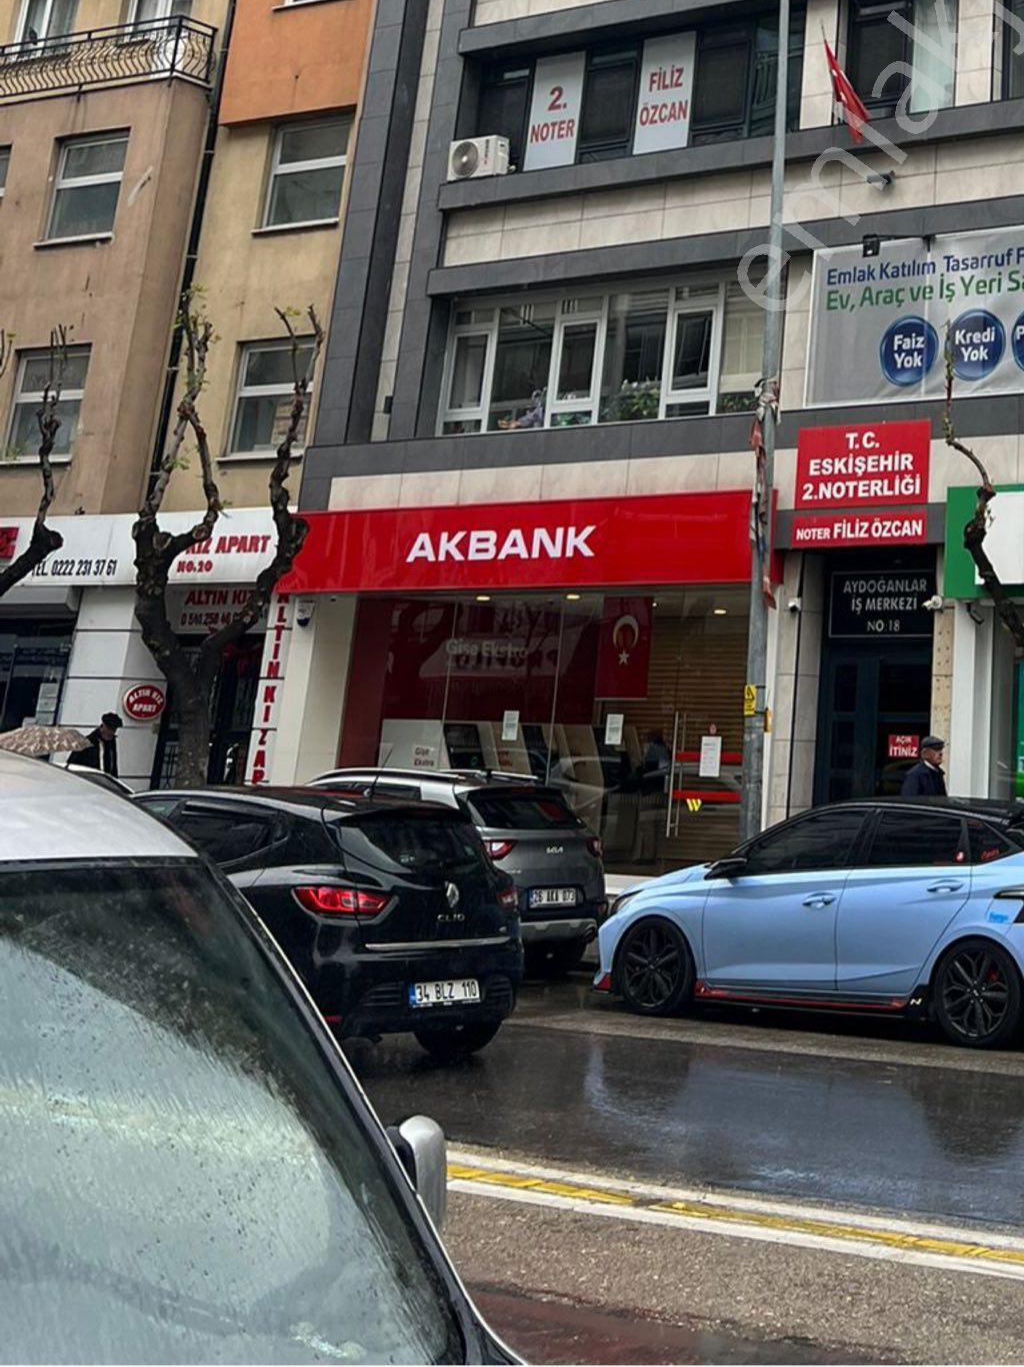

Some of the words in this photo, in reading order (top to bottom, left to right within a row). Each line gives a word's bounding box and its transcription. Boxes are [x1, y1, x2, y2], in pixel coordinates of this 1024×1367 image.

[649, 64, 684, 93] FİLİZ
[548, 86, 567, 111] 2.
[639, 99, 688, 127] ÖZCAN
[530, 119, 575, 143] NOTER
[827, 266, 876, 285] Emlak
[879, 259, 936, 281] Katılım
[943, 248, 1014, 273] Tasarruf
[826, 290, 855, 312] Ev,
[860, 285, 906, 312] Araç
[909, 285, 934, 301] ve
[939, 272, 956, 304] İş
[960, 271, 1003, 298] Yeri
[893, 333, 925, 351] Faiz
[955, 326, 995, 344] Kredi
[894, 352, 922, 369] Yok
[960, 346, 989, 362] Yok
[809, 451, 914, 476] ESKİŞEHİR
[796, 527, 831, 541] NOTER
[833, 519, 869, 539] FİLİZ
[871, 518, 923, 538] ÖZCAN
[215, 535, 271, 554] APART
[406, 525, 597, 562] AKBANK
[52, 560, 76, 576] 0222
[76, 560, 92, 576] 231
[94, 560, 106, 576] 37
[843, 575, 927, 594] AYDOĞANLAR
[185, 590, 228, 606] ALTIN
[865, 593, 917, 611] MERKEZİ
[415, 985, 430, 1002] 34
[435, 982, 455, 1000] BLZ
[461, 980, 477, 997] 110
